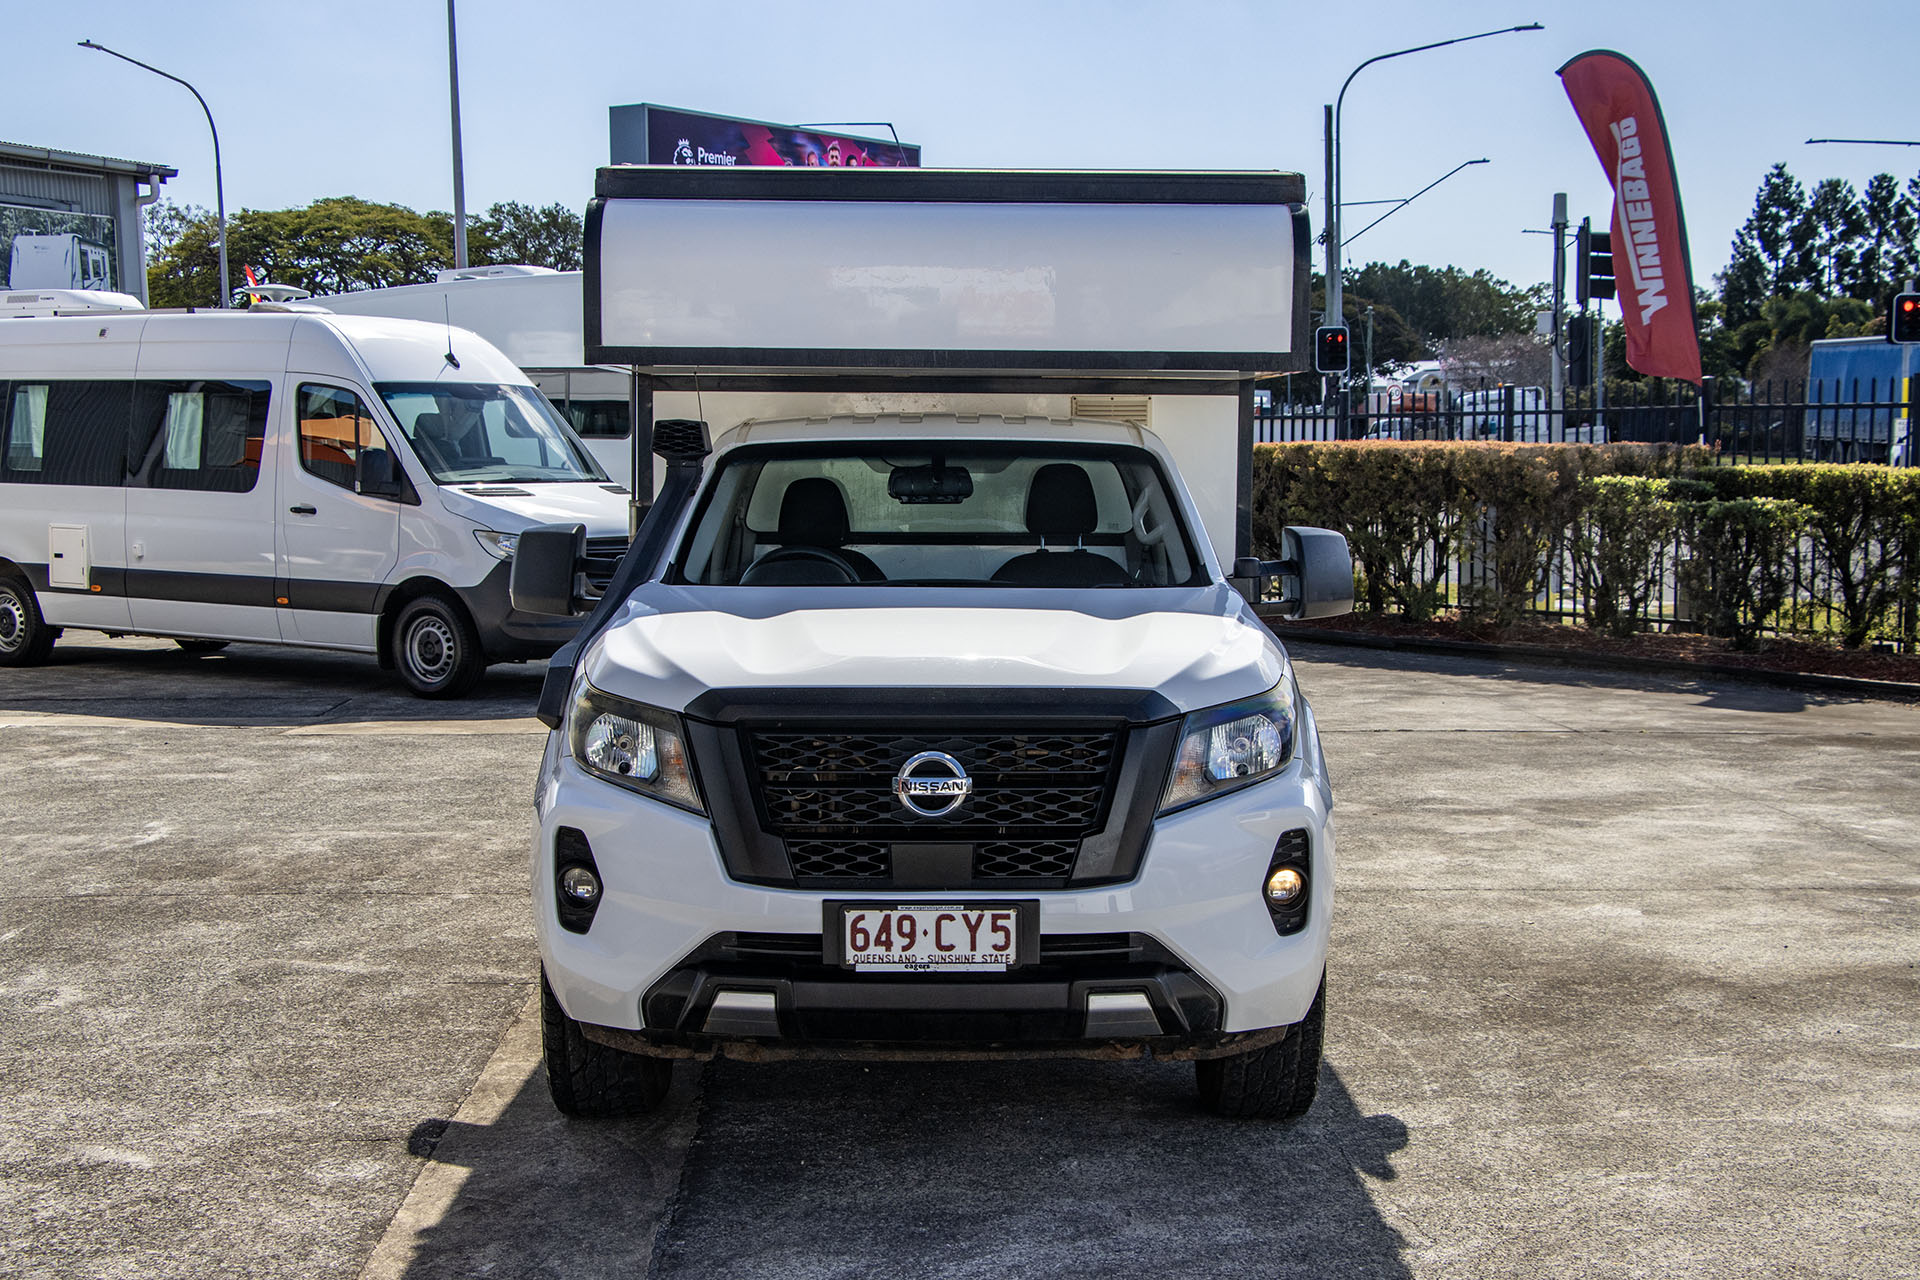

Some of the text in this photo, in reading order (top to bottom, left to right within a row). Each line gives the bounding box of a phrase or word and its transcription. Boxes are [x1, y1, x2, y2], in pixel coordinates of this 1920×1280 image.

[697, 146, 737, 166] Premier
[1616, 116, 1669, 326] WINNEBAGO
[901, 781, 964, 792] NISSAN
[852, 954, 918, 964] QUEENSLAND
[927, 954, 977, 963] SUNSHINE
[981, 954, 1011, 964] STATE
